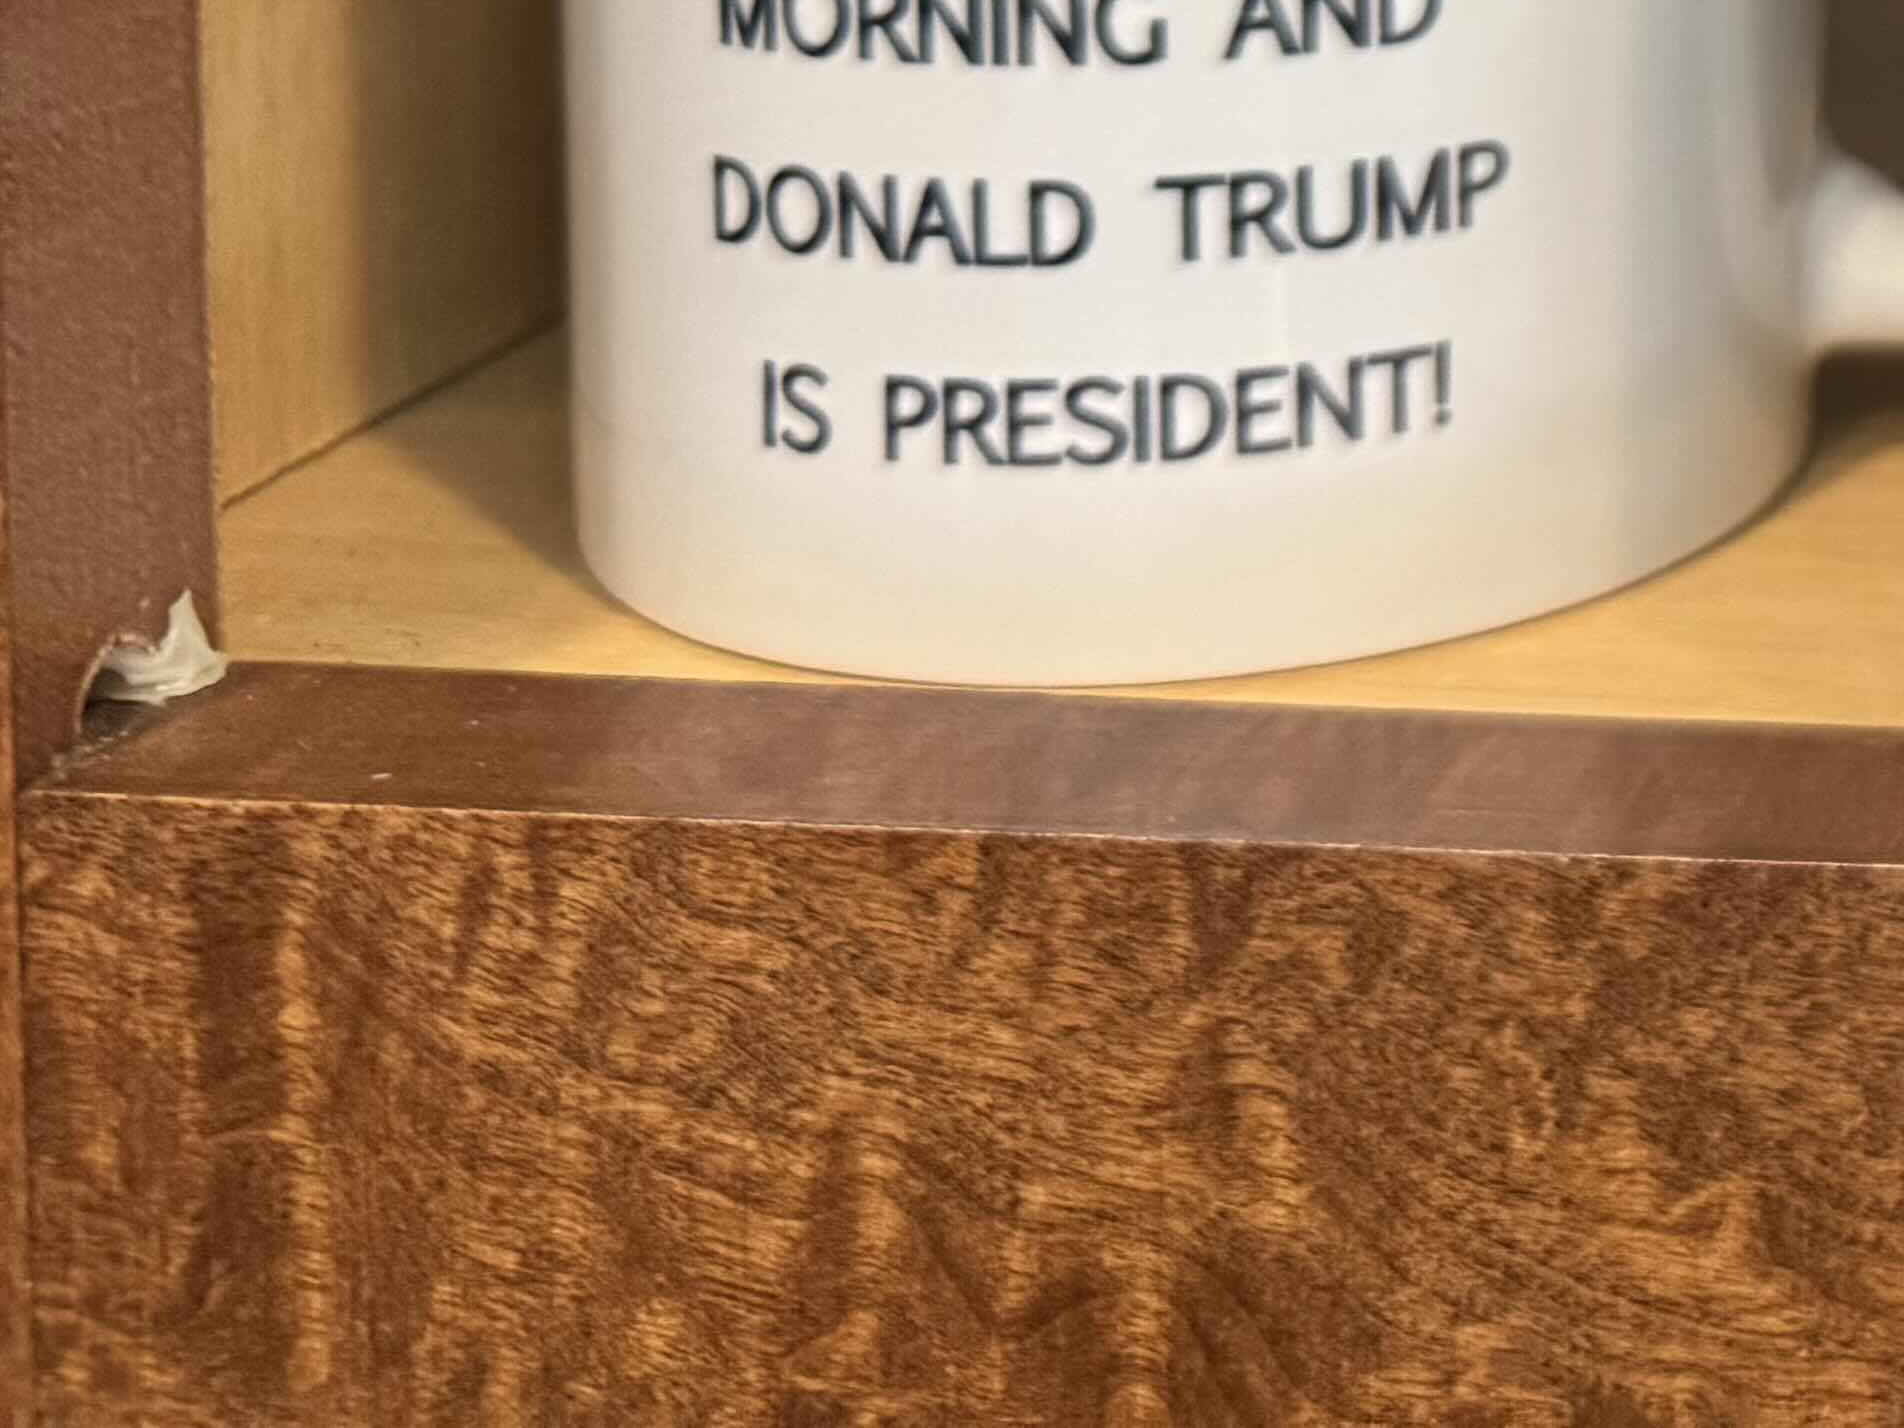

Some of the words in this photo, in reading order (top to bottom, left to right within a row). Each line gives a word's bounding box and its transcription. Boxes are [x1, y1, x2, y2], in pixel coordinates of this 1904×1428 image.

[713, 154, 1097, 267] DONALD
[1154, 139, 1511, 260] TRUMP
[762, 358, 832, 454] IS
[882, 339, 1454, 466] PRESIDENT!
